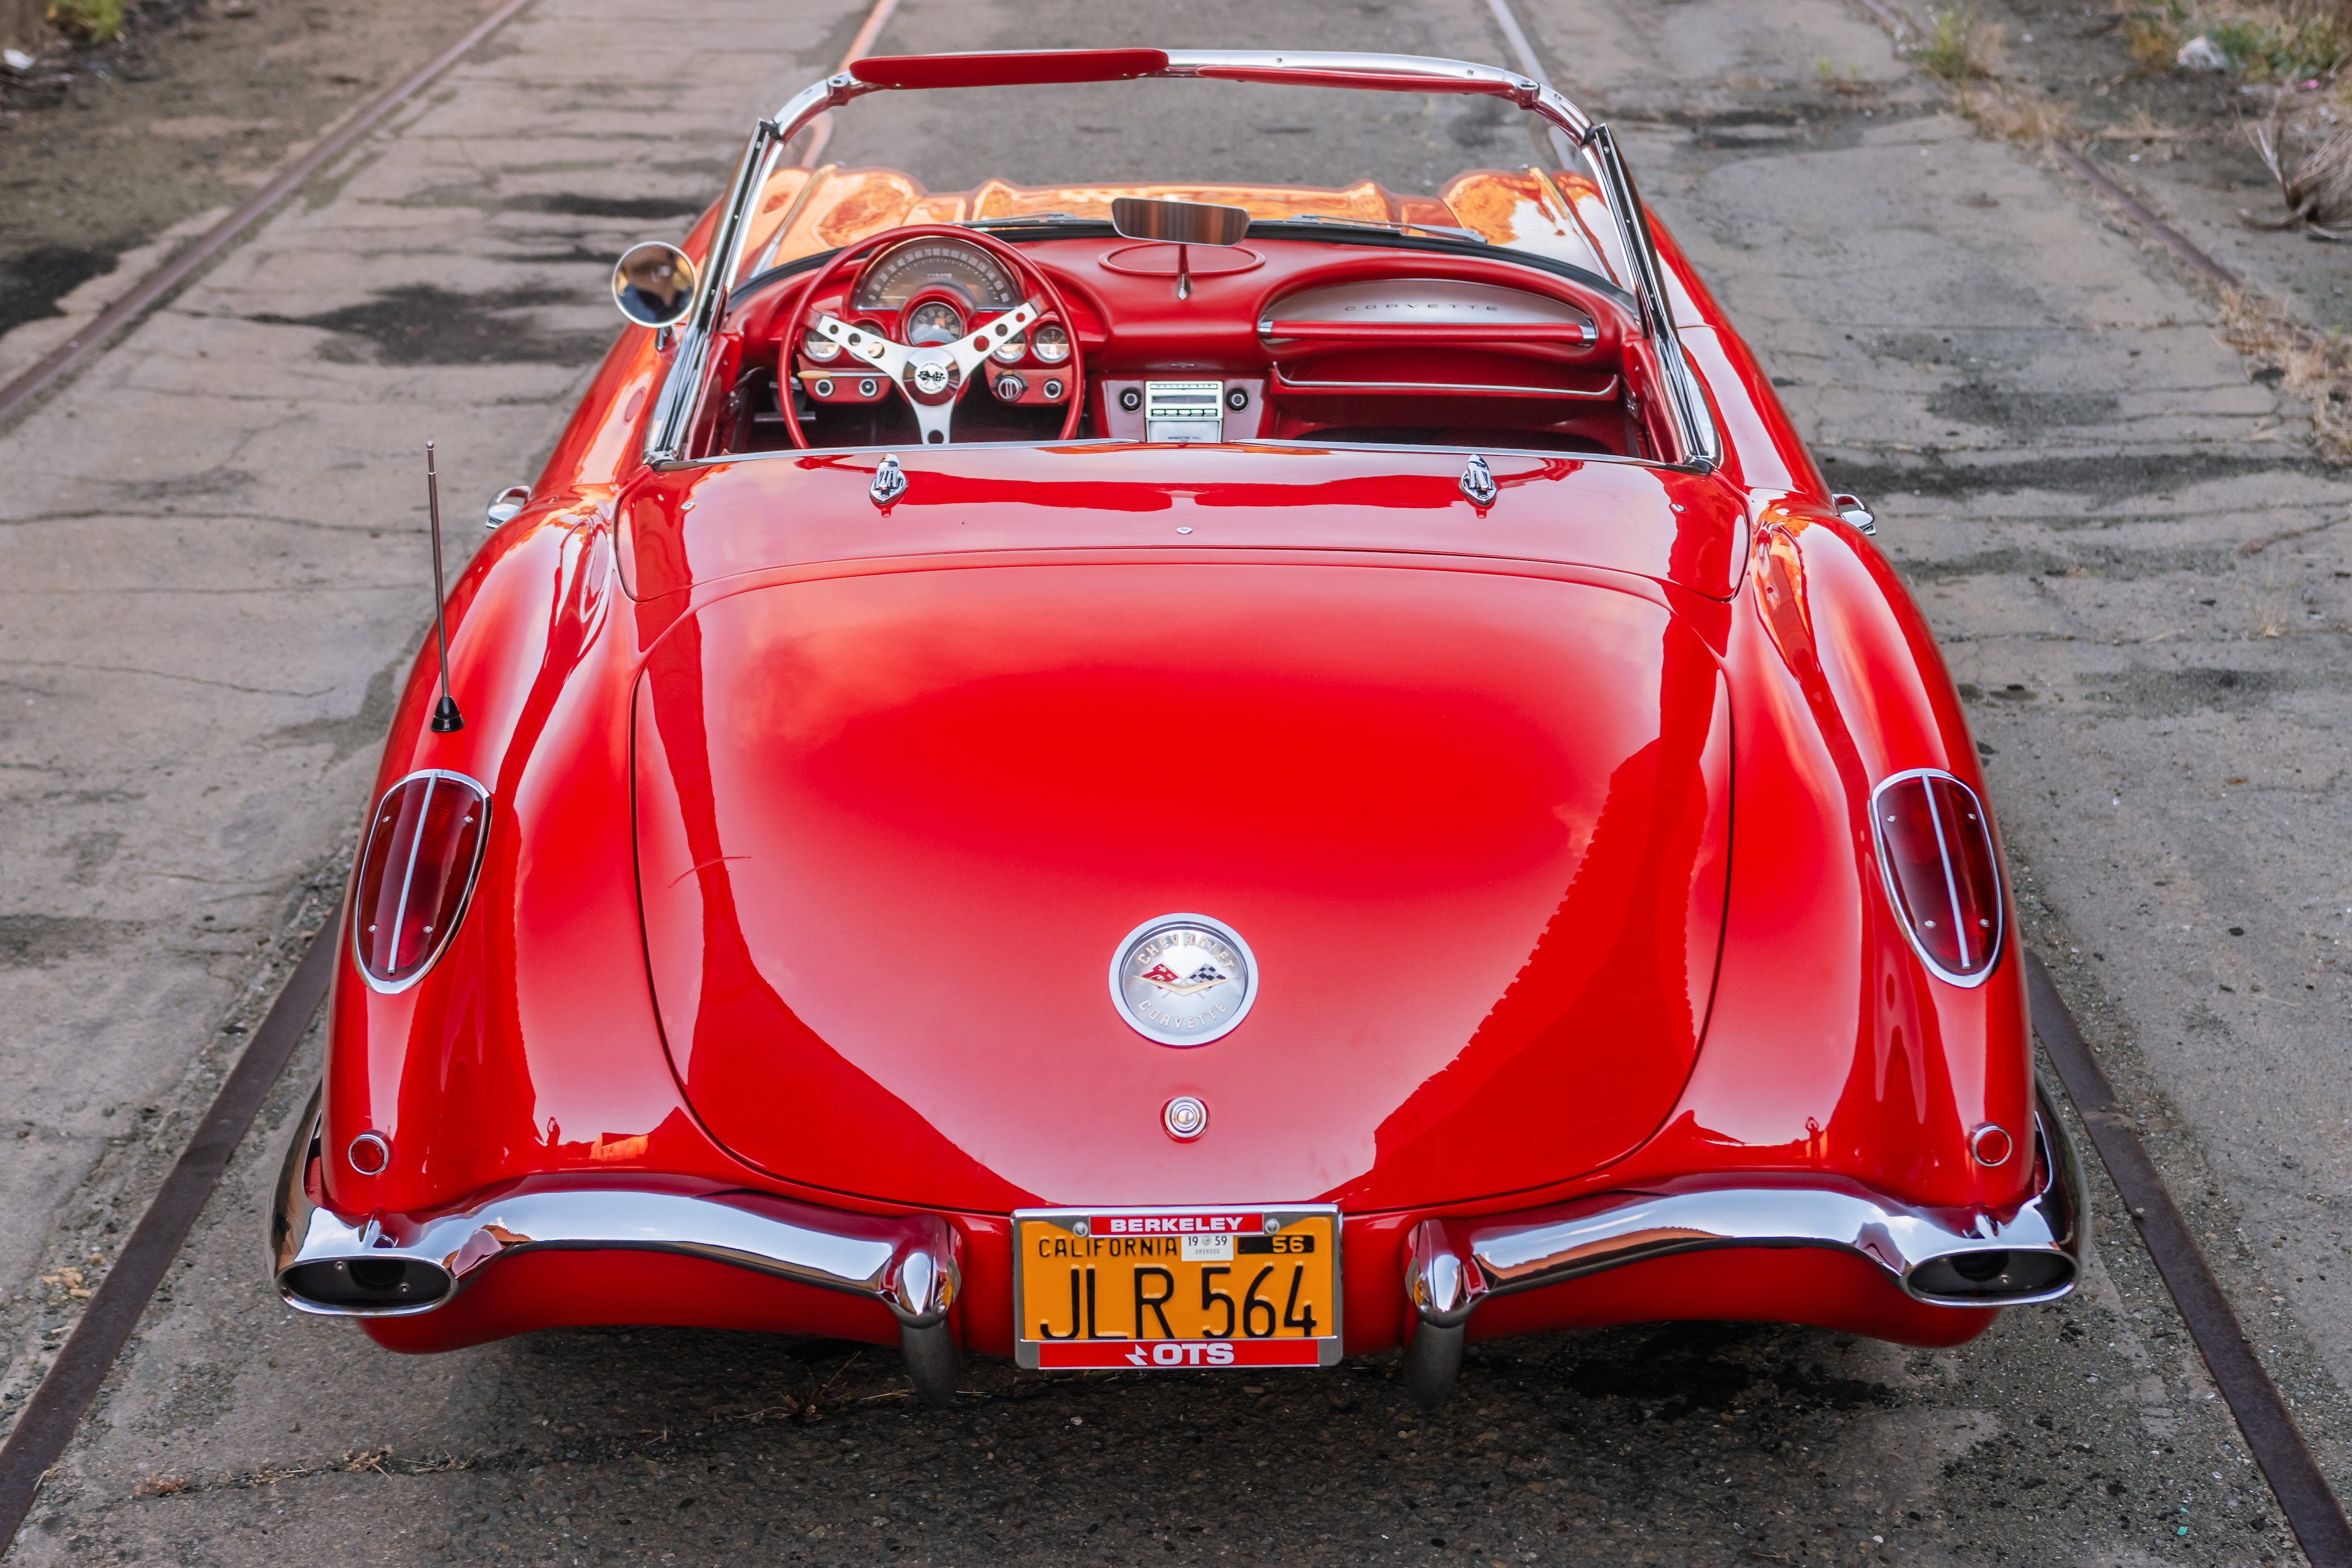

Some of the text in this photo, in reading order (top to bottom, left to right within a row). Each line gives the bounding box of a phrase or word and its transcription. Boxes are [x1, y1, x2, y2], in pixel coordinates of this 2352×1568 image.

[1137, 934, 1234, 969] CHEVROLET
[1138, 999, 1228, 1029] CORVETTE
[1111, 1217, 1243, 1232] BERKELEY
[1038, 1236, 1177, 1257] CALIFORNIA
[1188, 1236, 1227, 1246] 19 59
[1272, 1236, 1304, 1253] 56
[1040, 1261, 1317, 1339] JLR 564
[1153, 1343, 1235, 1365] OTS
